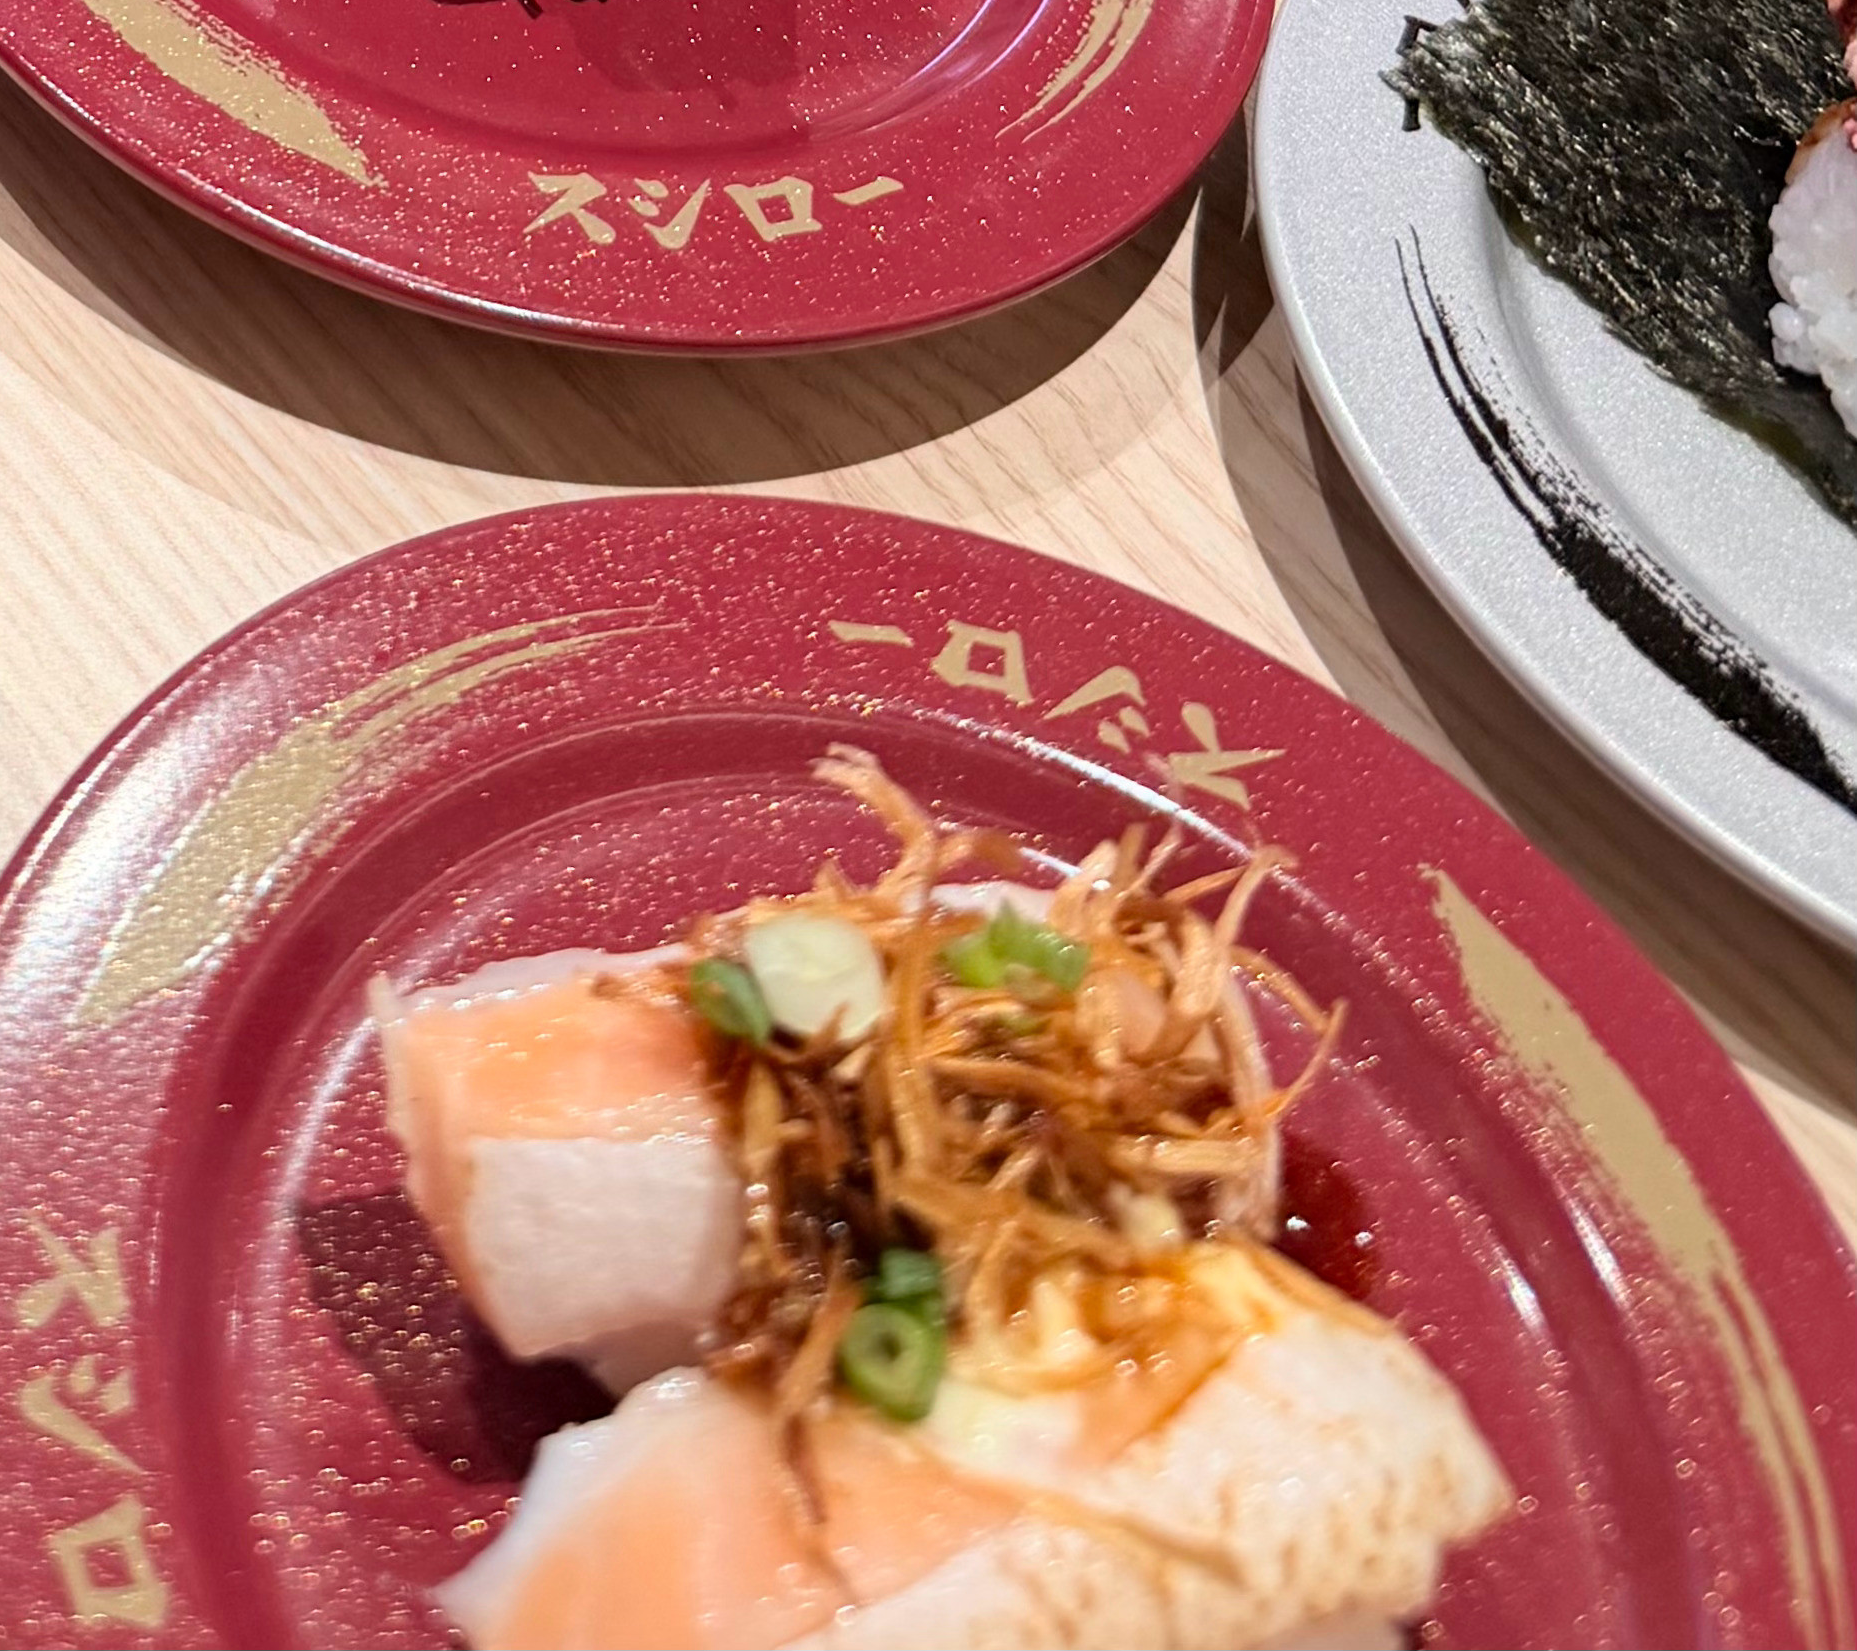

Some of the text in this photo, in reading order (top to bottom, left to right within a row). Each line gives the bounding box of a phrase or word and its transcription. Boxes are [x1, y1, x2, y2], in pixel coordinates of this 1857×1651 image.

[523, 170, 906, 253] スシロー
[828, 618, 1287, 811] スシロー
